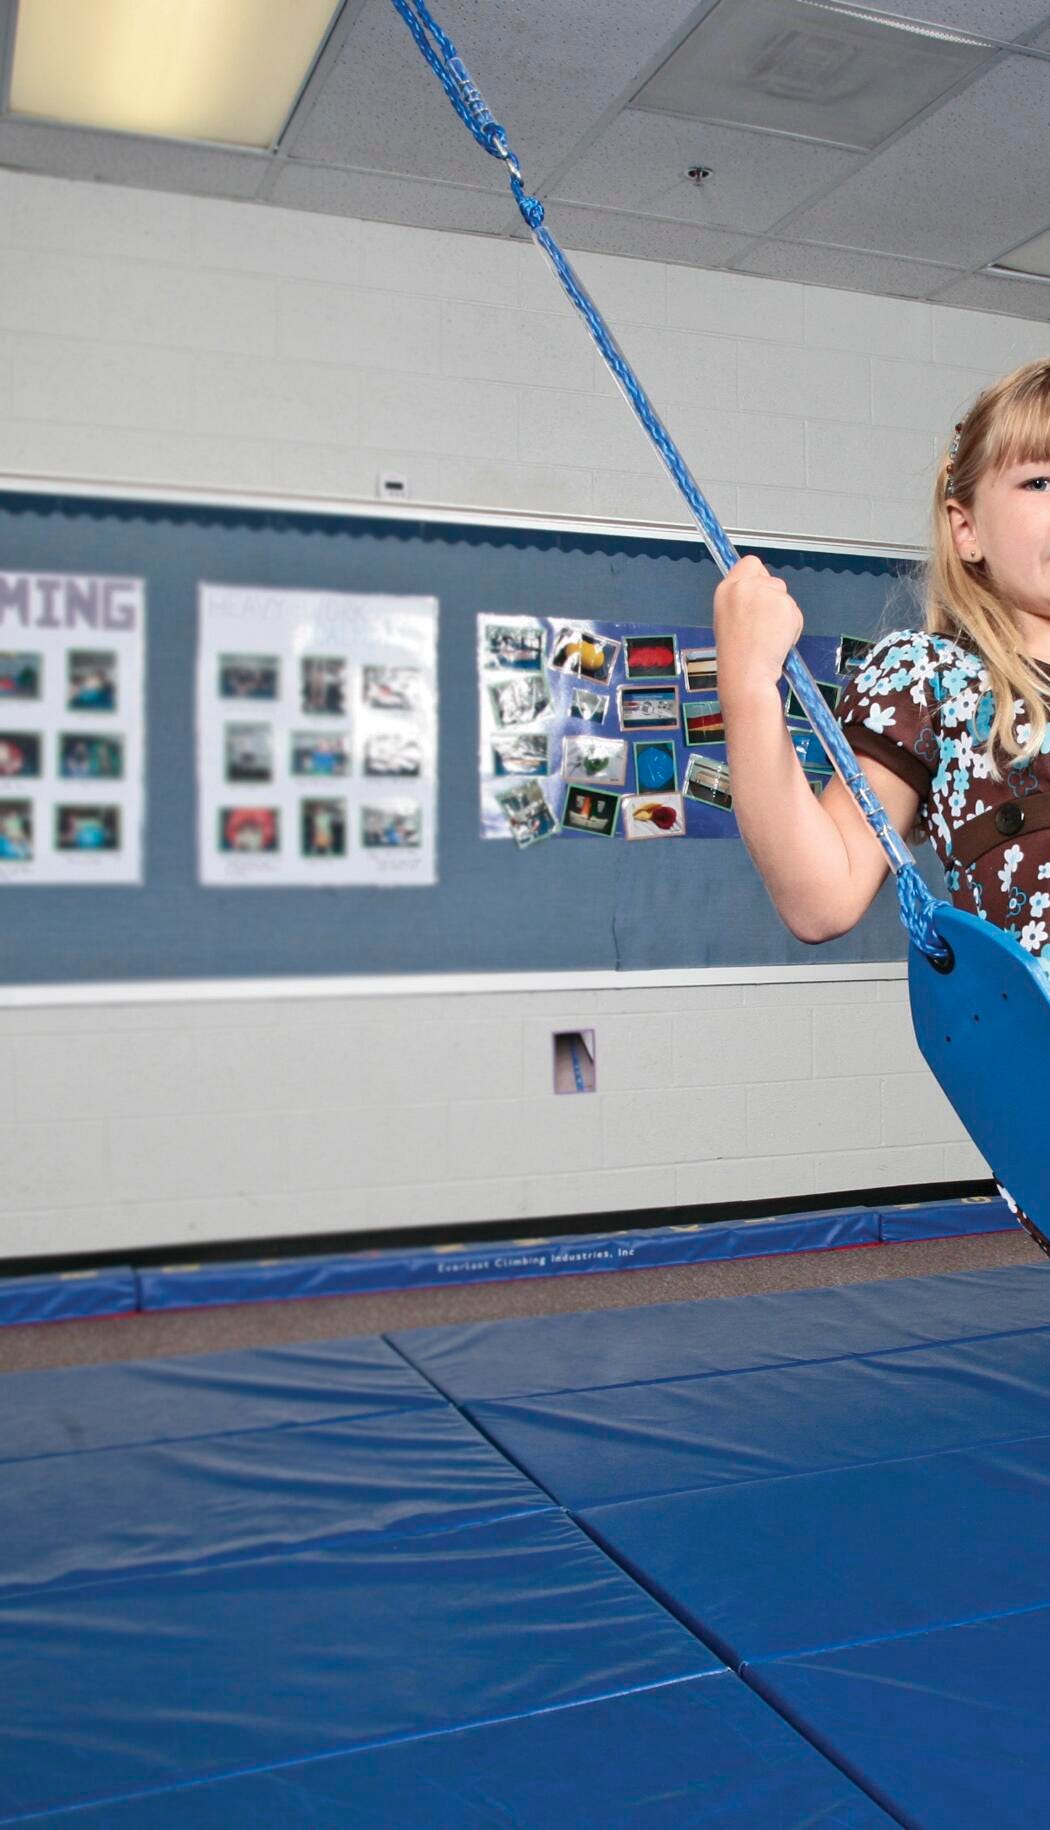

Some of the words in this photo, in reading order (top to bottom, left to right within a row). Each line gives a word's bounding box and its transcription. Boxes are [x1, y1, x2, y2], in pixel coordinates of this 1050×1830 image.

[437, 1261, 489, 1273] Everlast
[494, 1256, 546, 1268] Climbing
[618, 1247, 635, 1256] Inc
